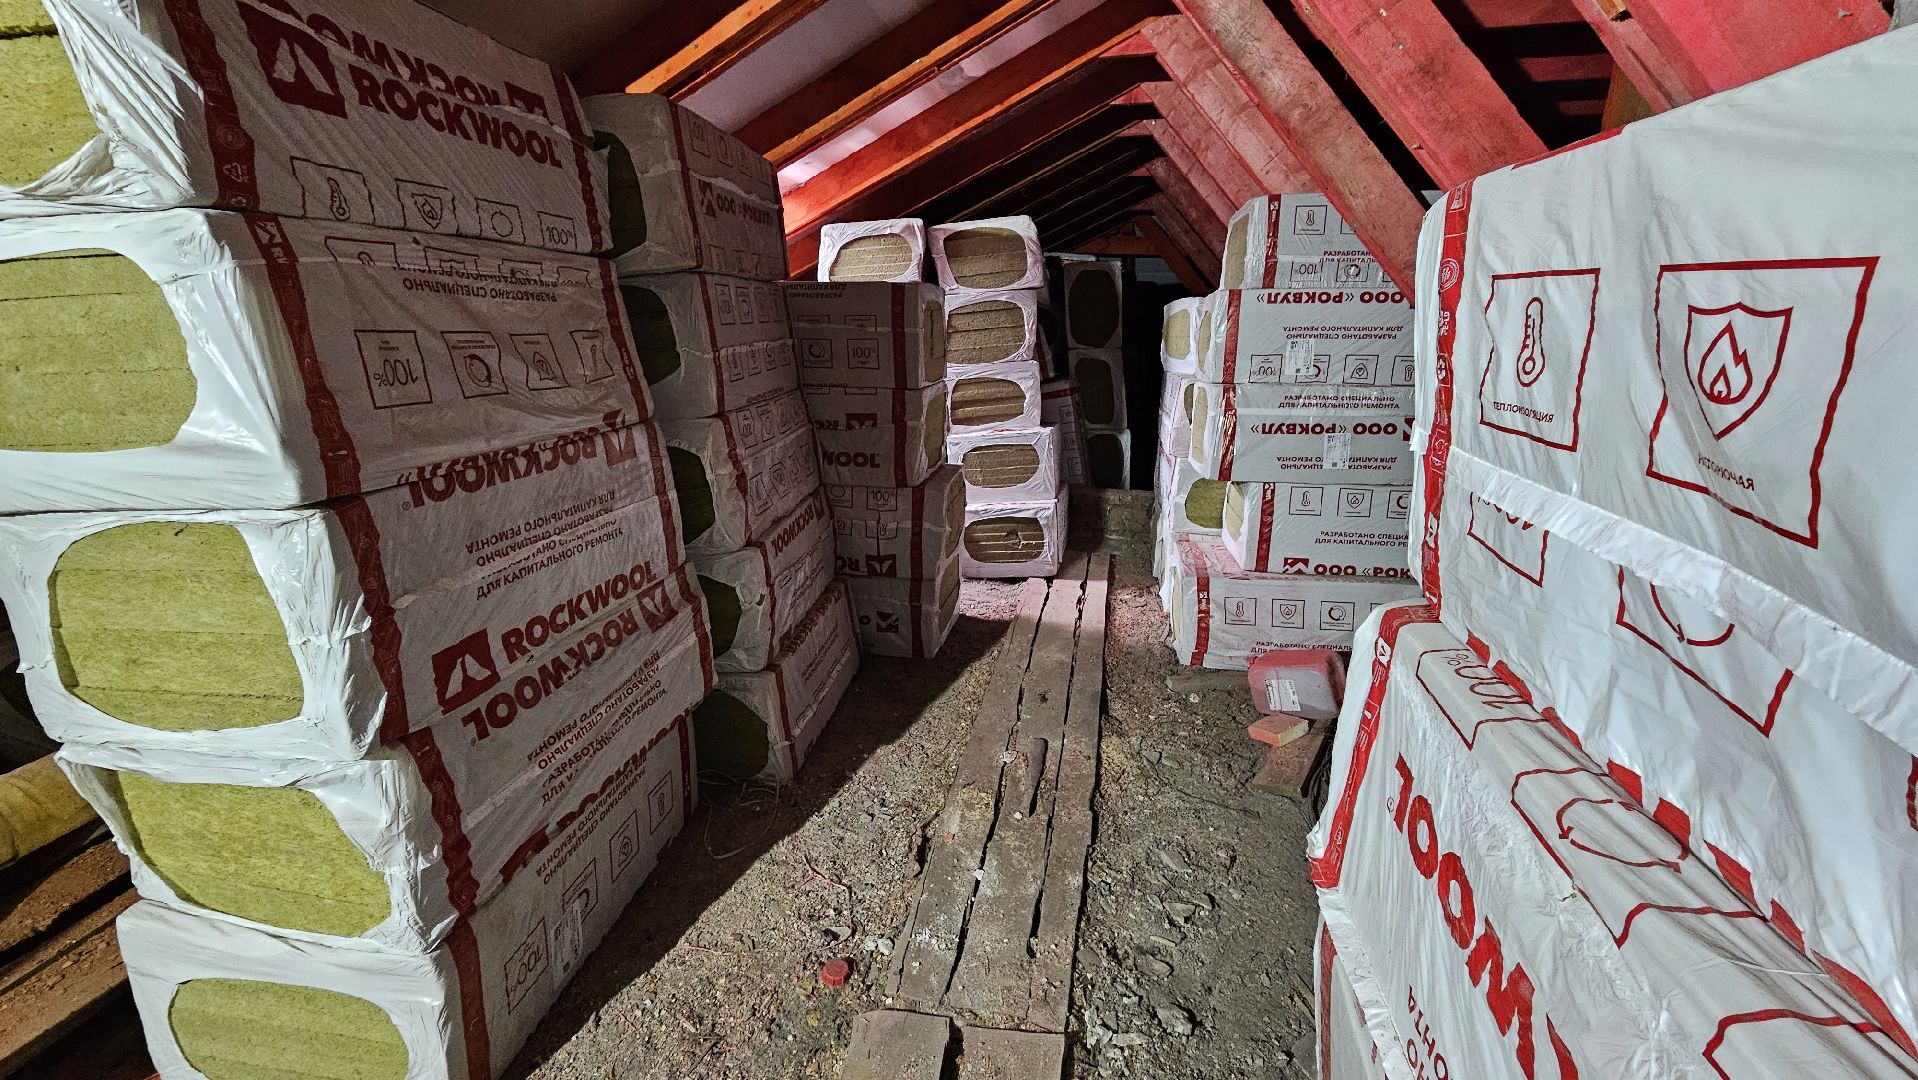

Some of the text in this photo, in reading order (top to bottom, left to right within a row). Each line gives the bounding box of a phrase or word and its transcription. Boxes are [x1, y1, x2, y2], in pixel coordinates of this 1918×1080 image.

[348, 62, 562, 169] ROCKWOOL
[402, 277, 557, 302] РАЗРАБОТАНО СПЕЦИАЛЬНО
[1256, 291, 1405, 305] ООО «РОКВУЛ»
[373, 357, 419, 388] 100%
[1250, 422, 1398, 435] ООО «РОКВУЛ»
[823, 451, 881, 469] WOOL
[523, 498, 598, 532] КАПИТАЛЬНОГО
[464, 526, 522, 554] РЕМОНТА
[1320, 531, 1409, 541] РАЗРАБОТАНО СПЕЦИА
[1333, 539, 1396, 547] КАПИТАЛЬНОГО
[476, 579, 504, 600] ДЛЯ
[502, 543, 583, 587] КАПИТАЛЬНОГО
[584, 527, 624, 551] РЕМОНТА
[1314, 563, 1357, 576] ООО
[501, 560, 657, 664] ROCKWOOL
[1312, 643, 1353, 651] СПЕЦИАЛЬ
[460, 607, 641, 742] ROCKWOOL
[604, 664, 661, 715] РАЗРАБОТАНО
[537, 710, 605, 770] СПЕЦИАЛЬНО
[534, 828, 576, 877] РЕМОНТА
[1394, 752, 1580, 1080] WOOL
